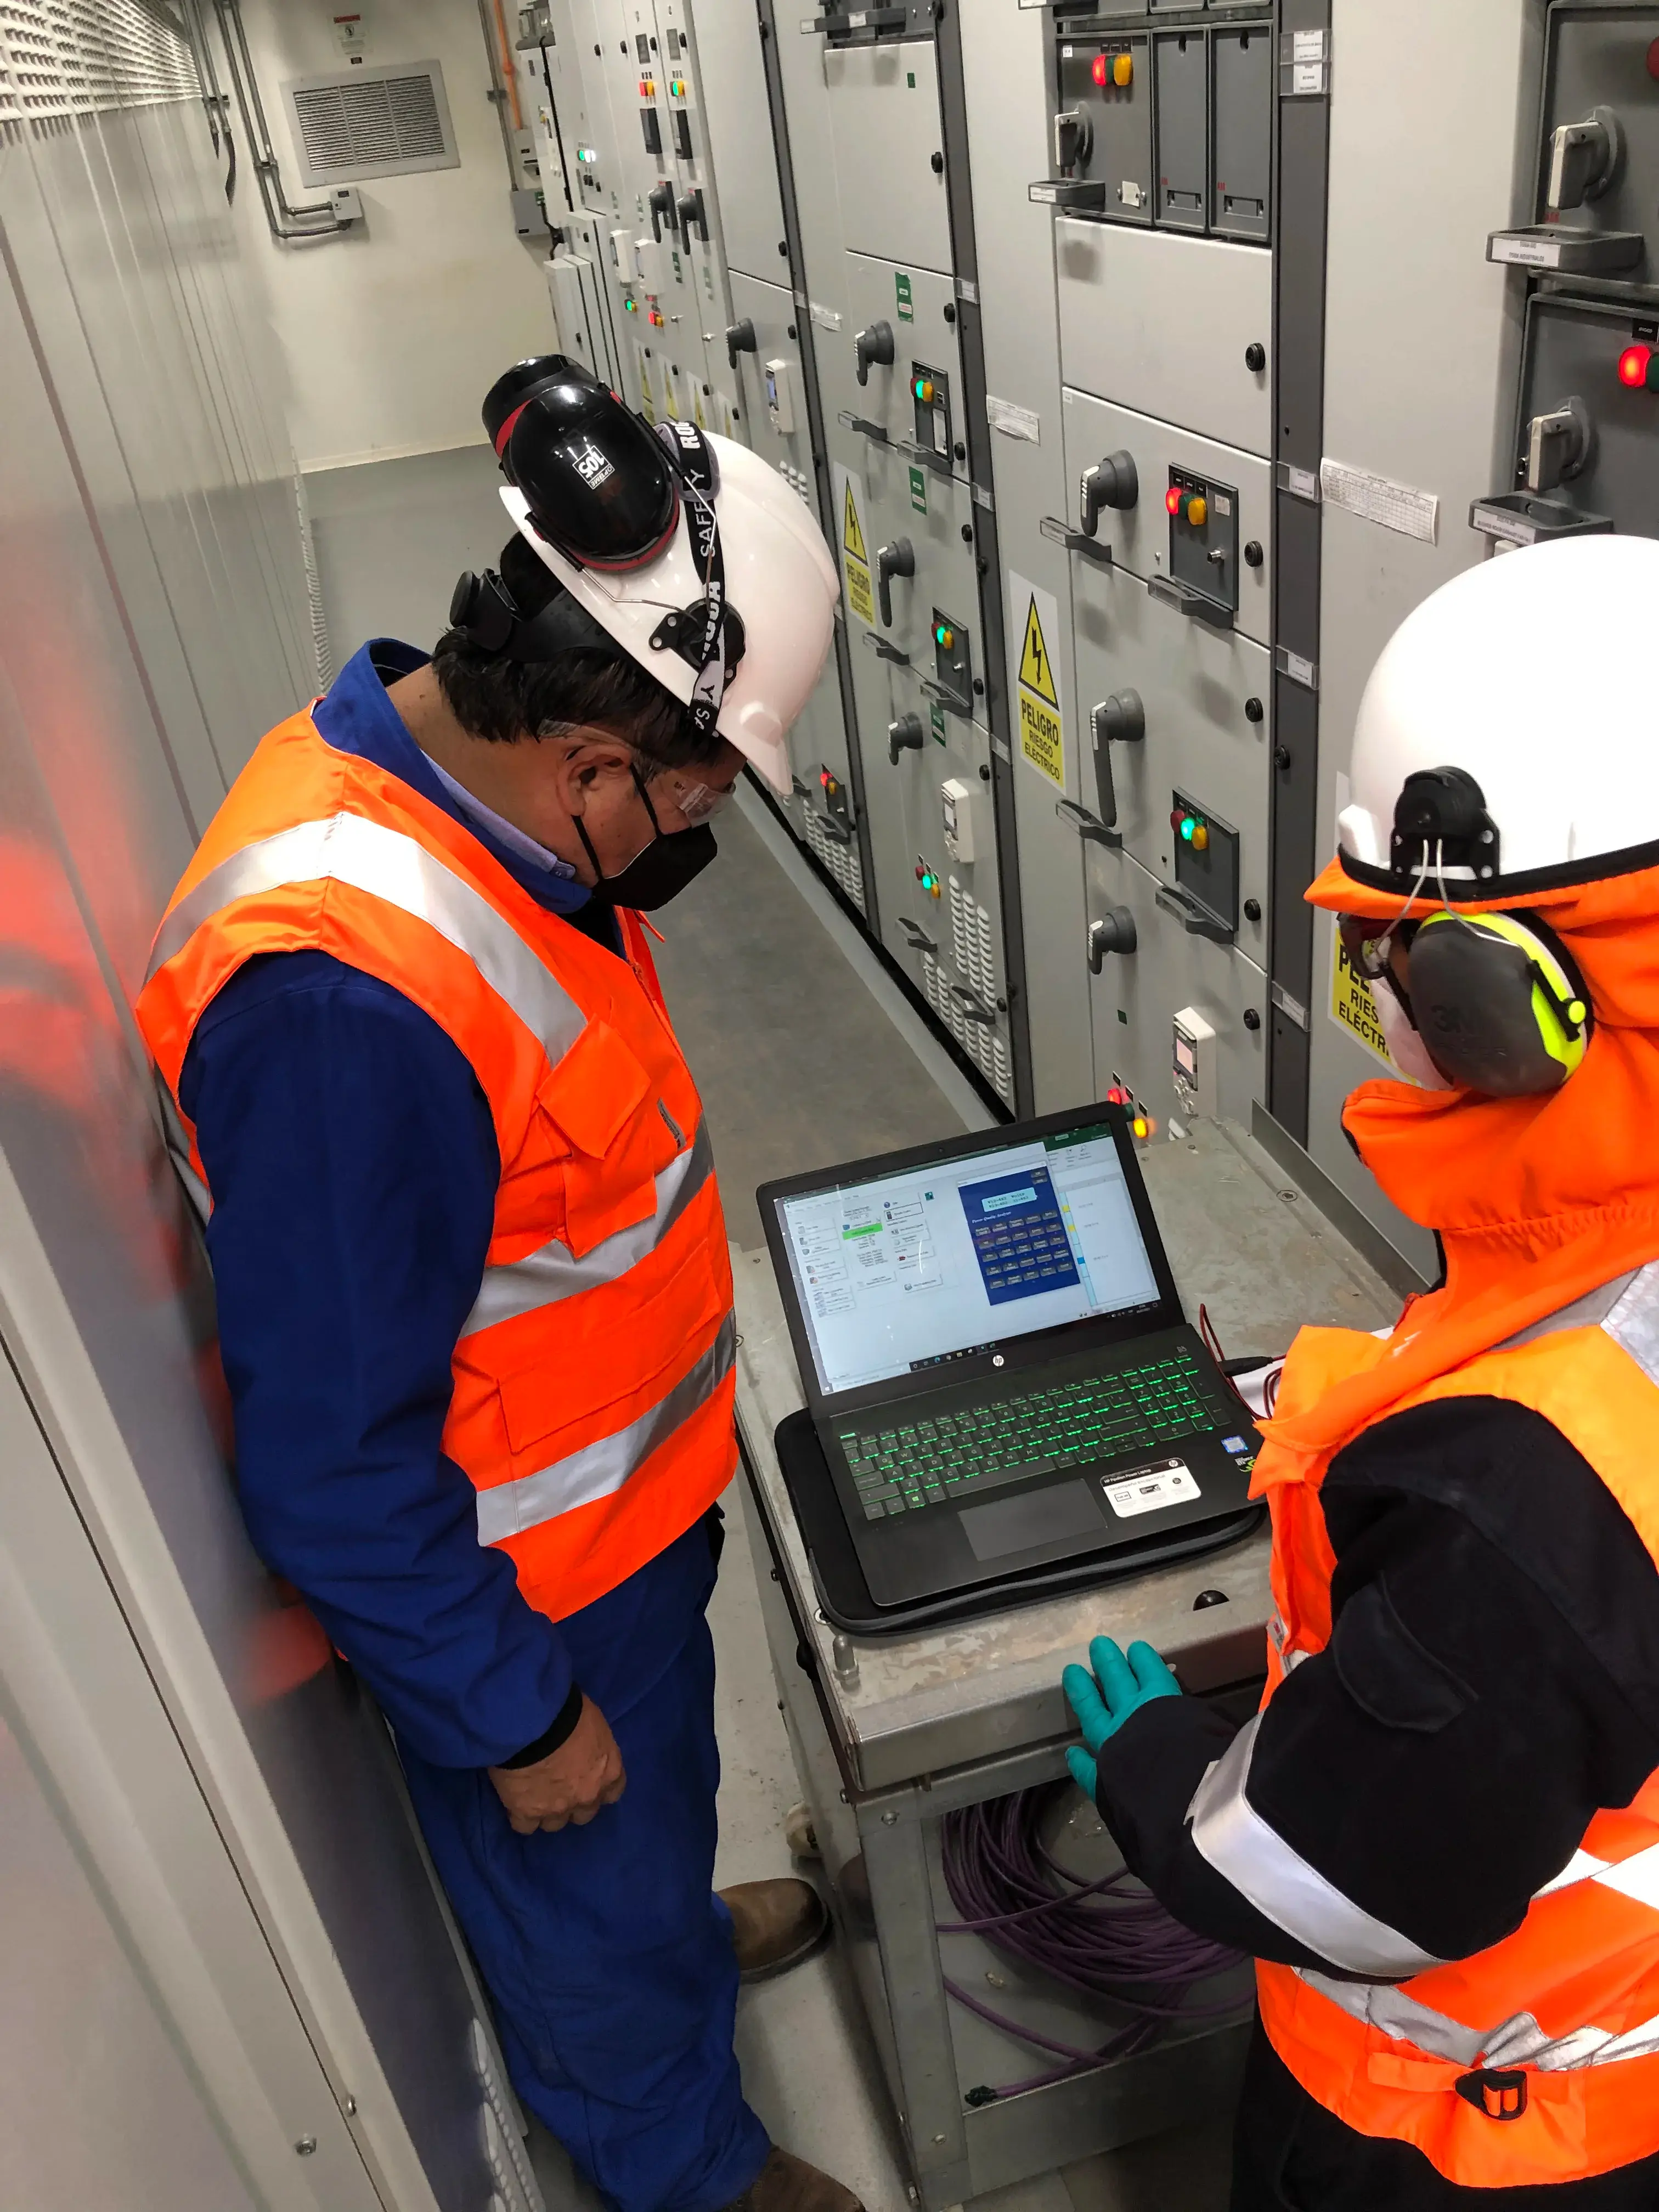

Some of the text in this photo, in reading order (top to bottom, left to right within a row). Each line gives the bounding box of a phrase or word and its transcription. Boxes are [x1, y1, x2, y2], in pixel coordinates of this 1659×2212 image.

[578, 451, 605, 479] 105
[590, 466, 613, 488] OPTIME
[1022, 698, 1059, 747] PELIGRO
[1029, 729, 1053, 758] RIESGO
[1339, 1000, 1390, 1057] ELÉCTR
[994, 1355, 1003, 1366] hp
